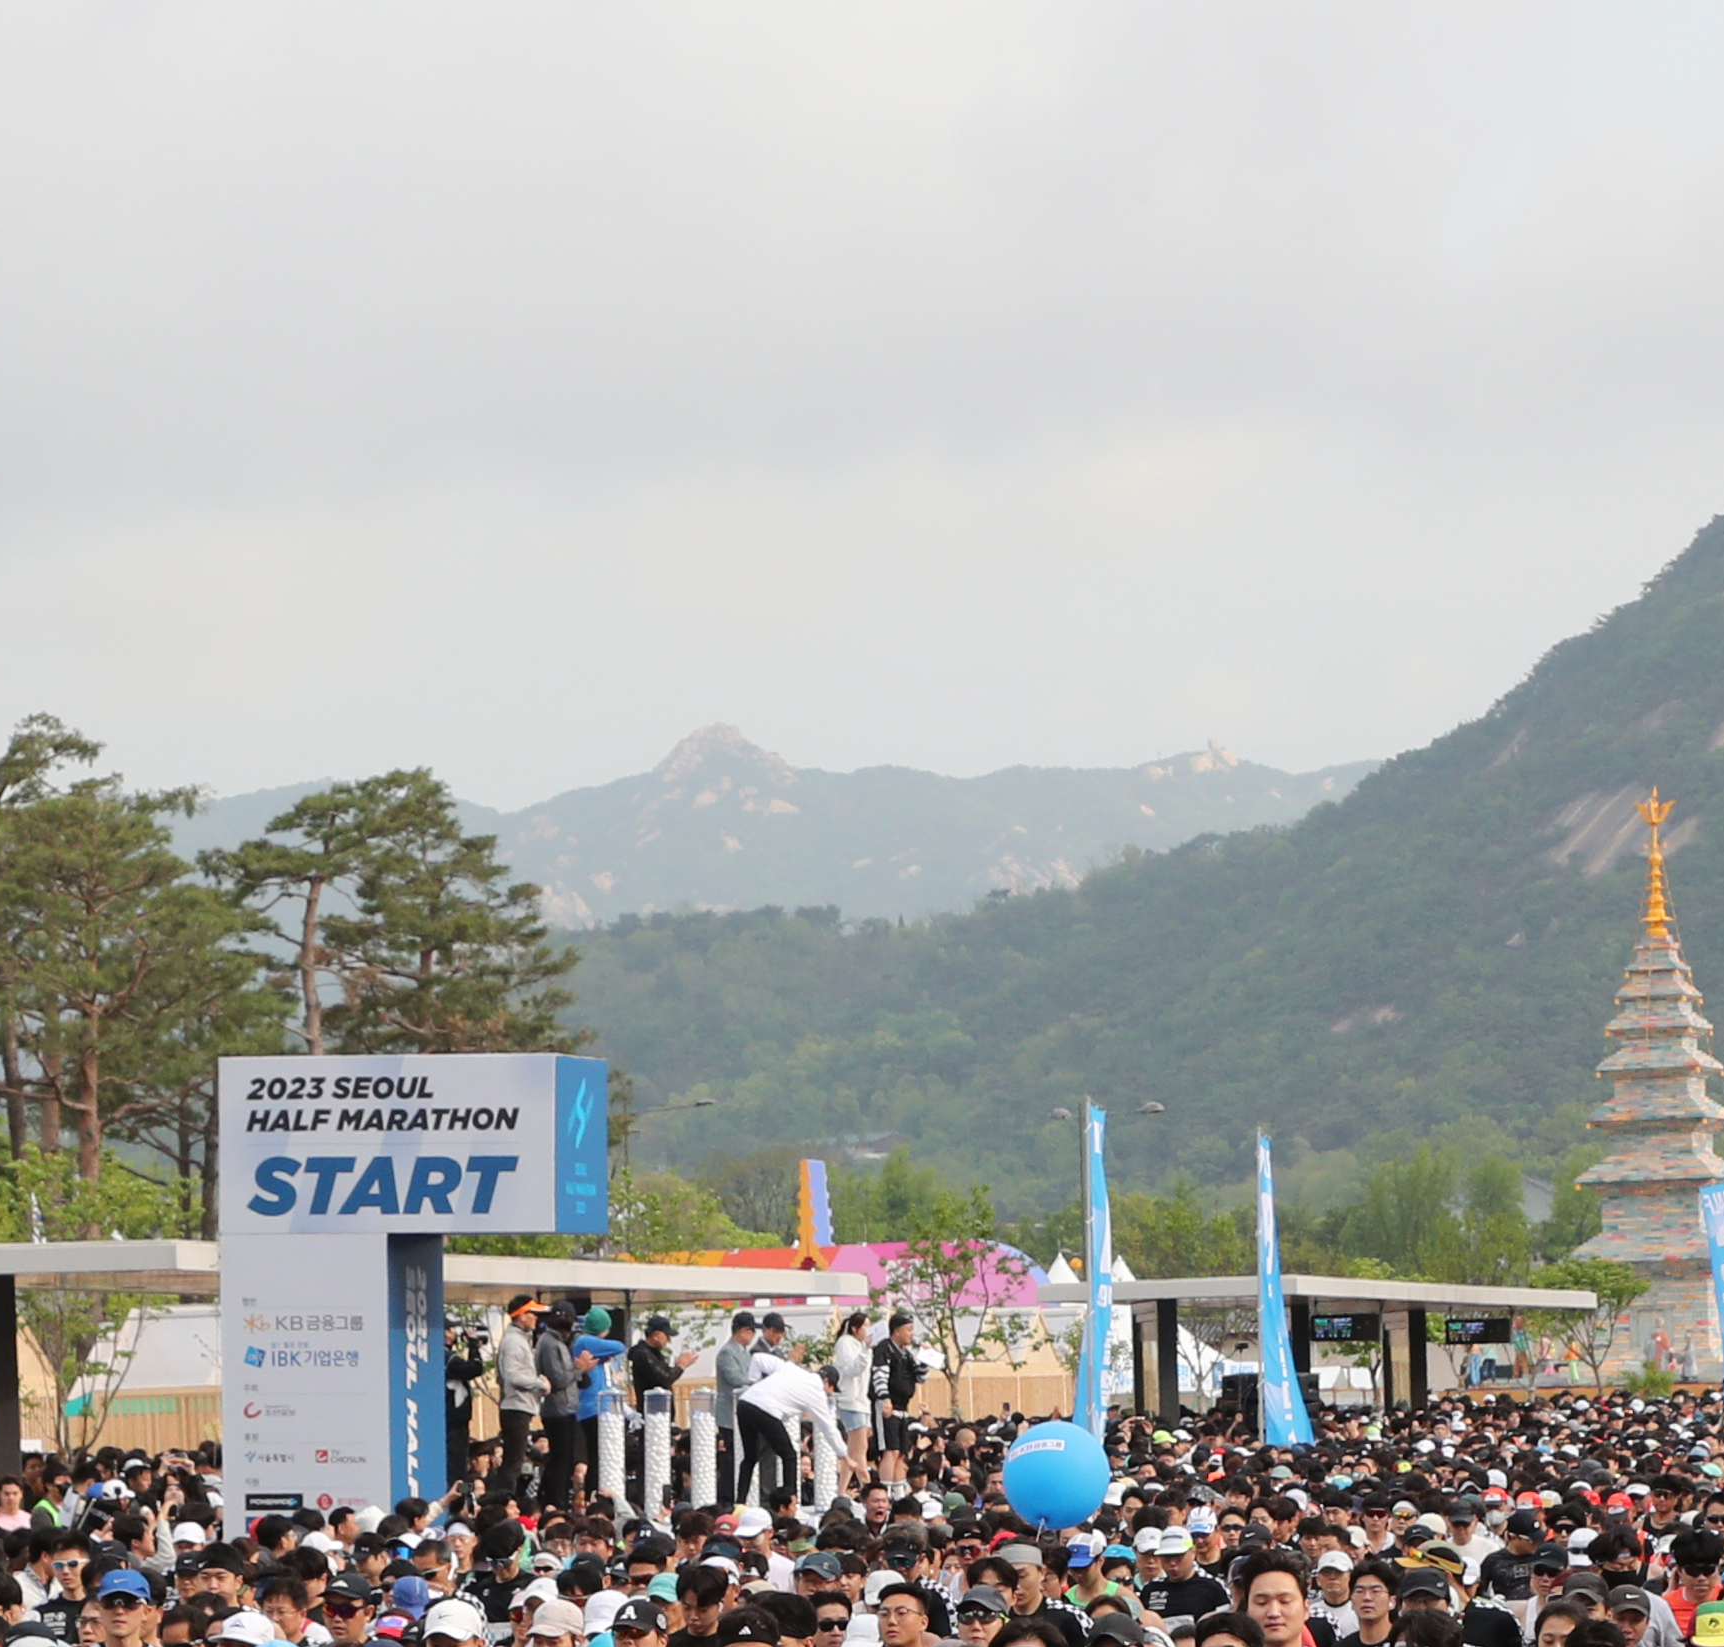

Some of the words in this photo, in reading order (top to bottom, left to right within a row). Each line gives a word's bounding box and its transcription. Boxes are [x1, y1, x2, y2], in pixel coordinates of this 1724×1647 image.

[246, 1077, 326, 1101] 2023
[331, 1076, 434, 1100] SEOUL
[246, 1109, 332, 1133] HALF
[337, 1107, 520, 1132] MARATHON
[246, 1155, 520, 1217] START
[275, 1315, 364, 1332] KB금융그룹
[405, 1265, 420, 1389] SEOUL
[271, 1349, 359, 1368] IBK기업은행
[406, 1398, 421, 1499] HALF
